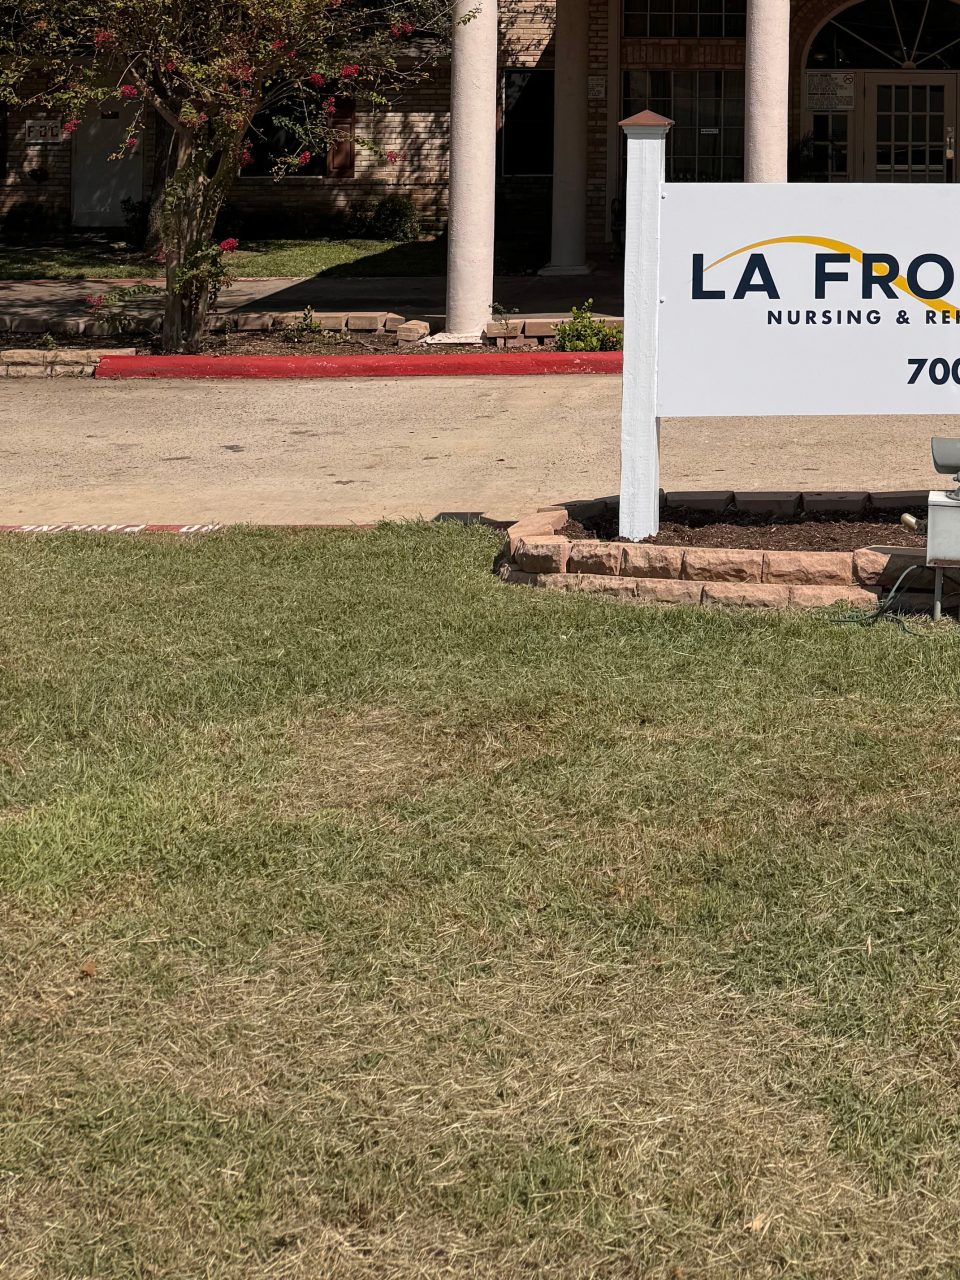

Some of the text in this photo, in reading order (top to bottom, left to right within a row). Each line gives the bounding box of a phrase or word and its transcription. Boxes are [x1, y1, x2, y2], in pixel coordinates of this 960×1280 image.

[691, 253, 781, 300] LA
[767, 309, 881, 325] NURSING
[895, 309, 911, 325] &
